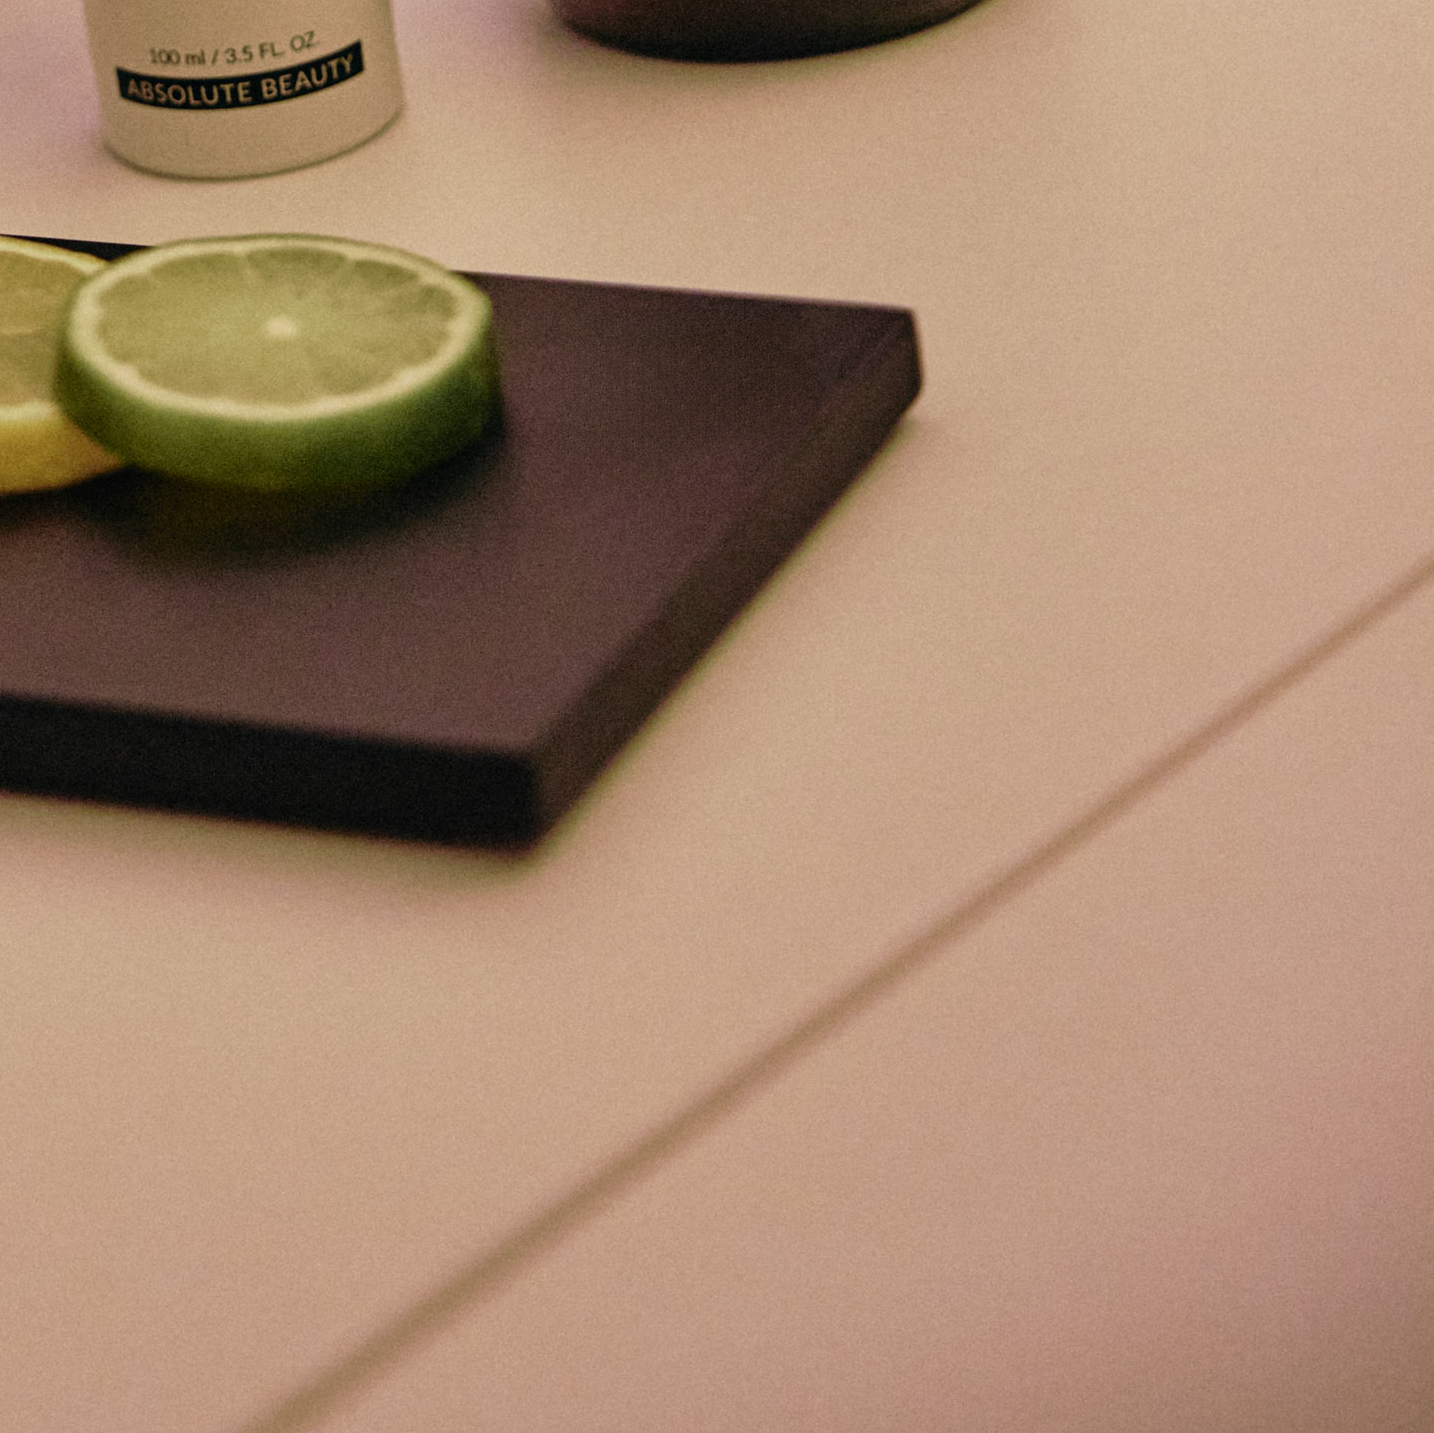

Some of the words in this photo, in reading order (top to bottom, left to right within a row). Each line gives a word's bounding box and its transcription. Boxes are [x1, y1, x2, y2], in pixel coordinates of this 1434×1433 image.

[150, 47, 181, 65] 100
[184, 48, 206, 65] ml
[211, 48, 219, 66] /
[224, 45, 254, 64] 3.5
[127, 78, 252, 105] ABSOLUTE
[261, 53, 354, 100] BEAUTY
